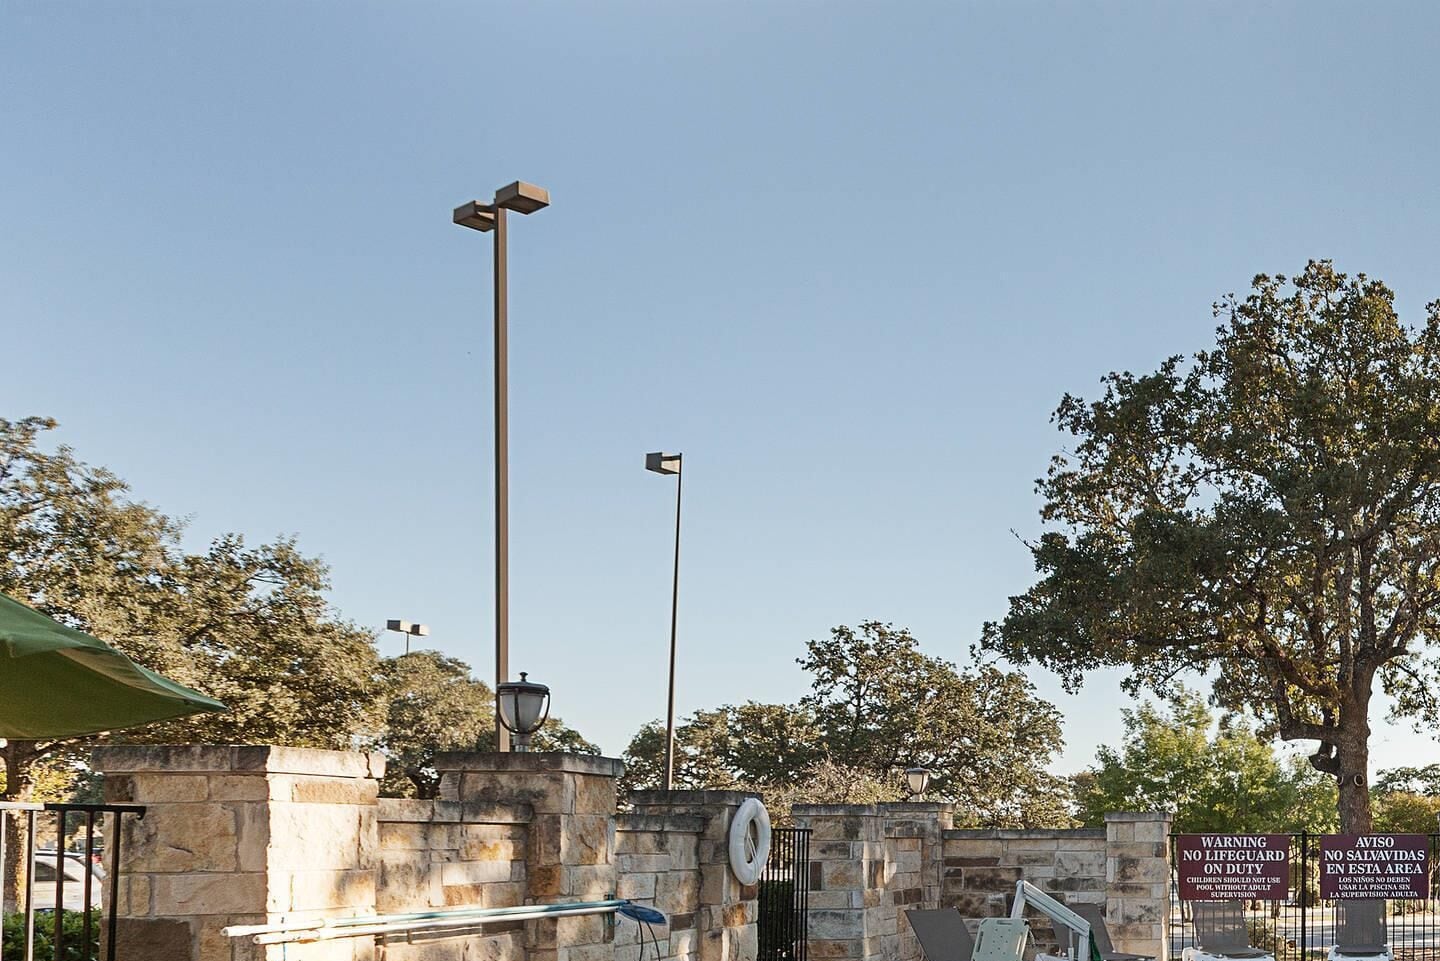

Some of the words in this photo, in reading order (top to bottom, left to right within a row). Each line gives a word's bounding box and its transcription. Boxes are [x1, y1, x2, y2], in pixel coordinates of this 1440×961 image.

[1201, 836, 1267, 848] WARNING
[1355, 836, 1395, 848] AVISO
[1183, 849, 1202, 861] NO
[1205, 849, 1285, 861] LIFEGUARD
[1324, 850, 1343, 861] NO
[1346, 849, 1425, 861] SALVAVIDAS
[1203, 863, 1222, 874] ON
[1226, 863, 1264, 874] DUTY
[1326, 863, 1345, 874] EN
[1348, 863, 1381, 874] ESTA
[1384, 863, 1423, 874] AREA
[1352, 875, 1375, 883] NIÑOS
[1389, 890, 1418, 898] ADULTA
